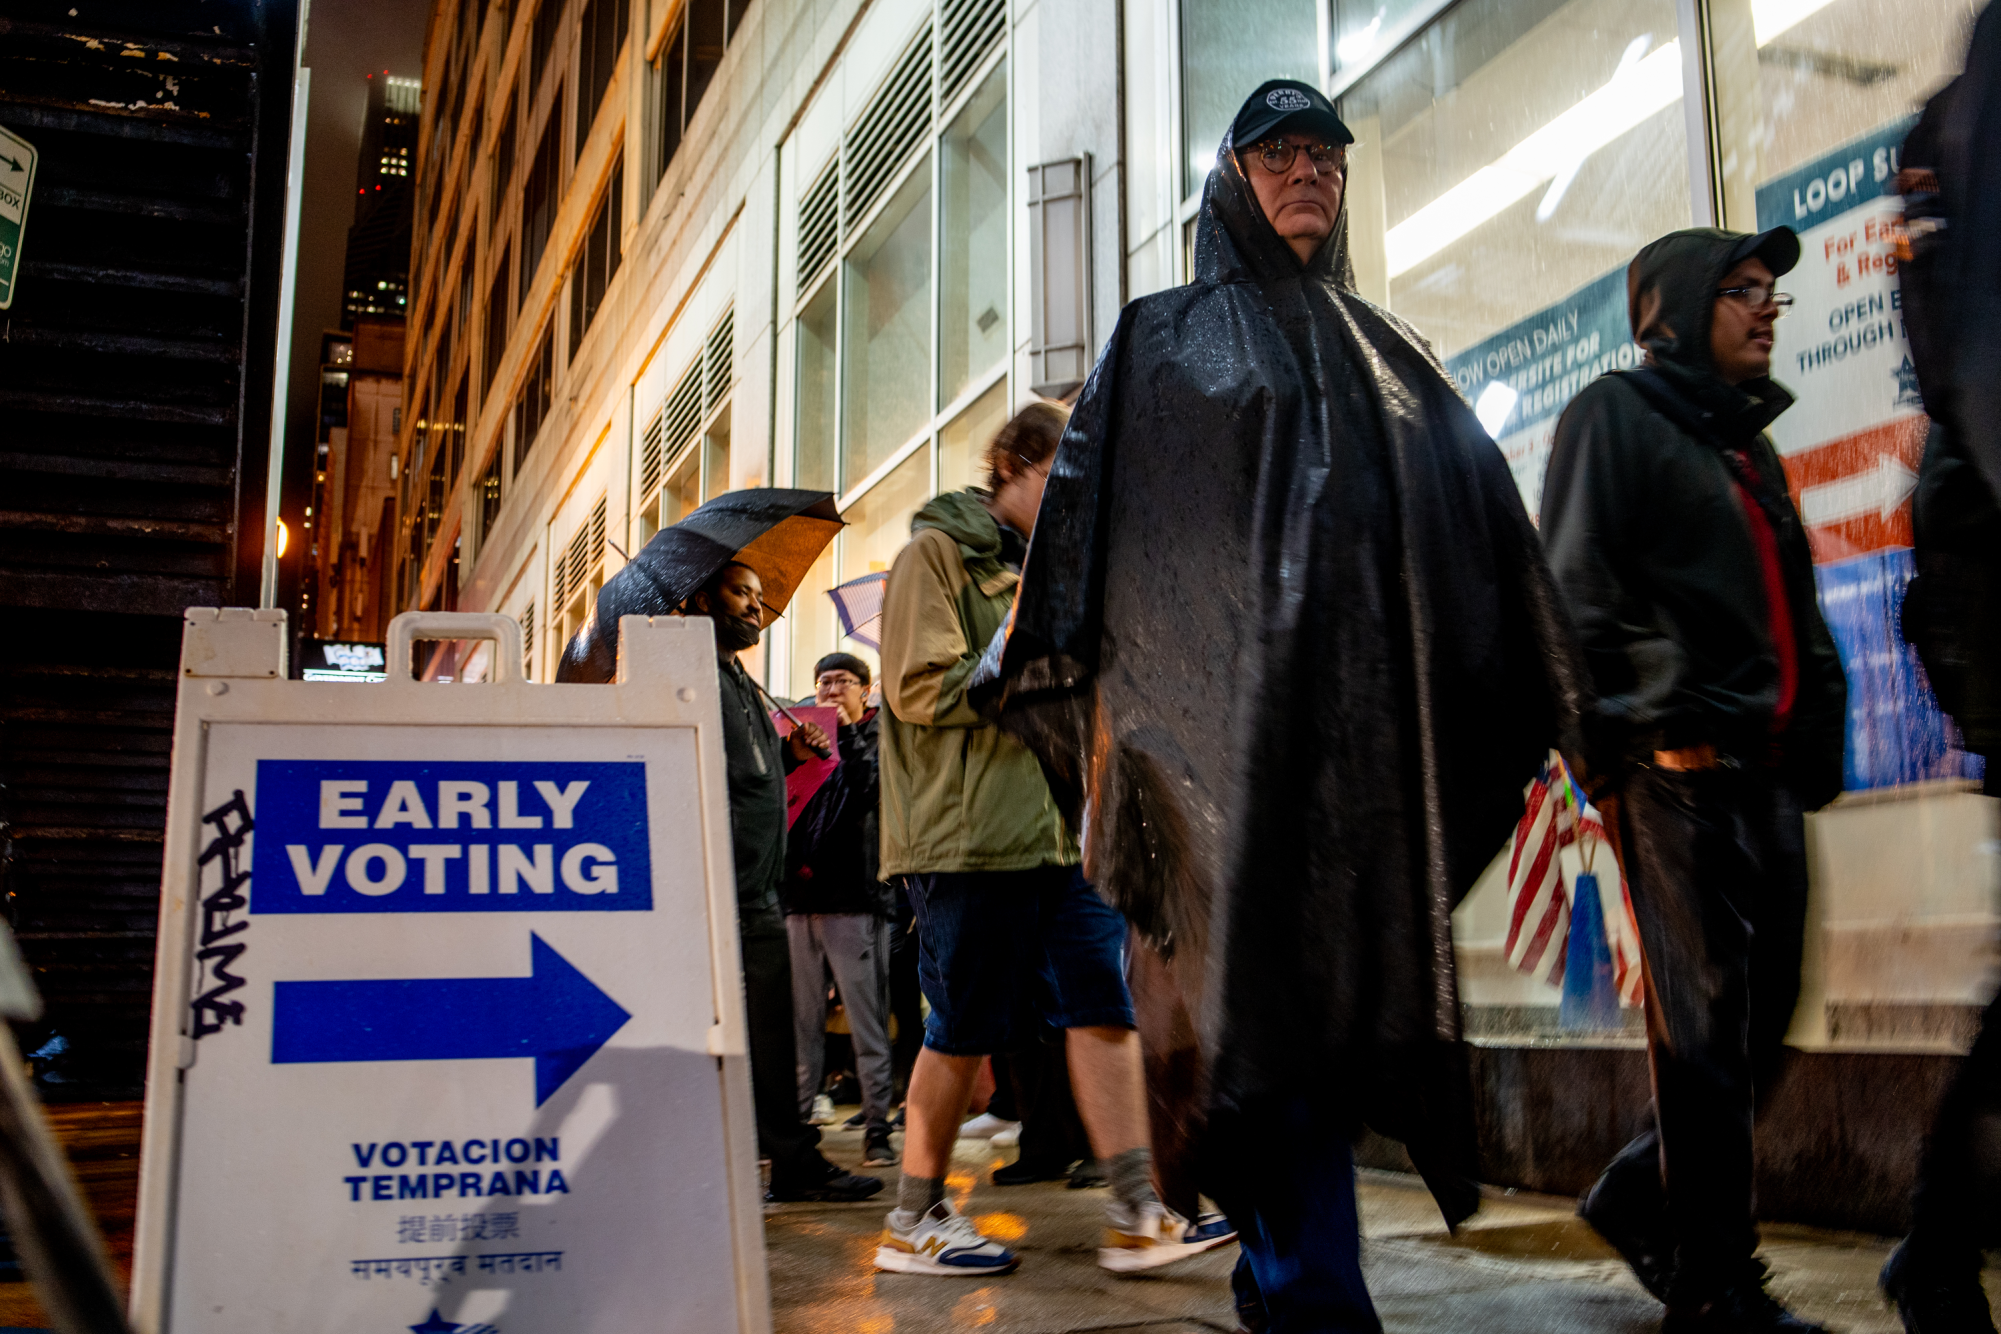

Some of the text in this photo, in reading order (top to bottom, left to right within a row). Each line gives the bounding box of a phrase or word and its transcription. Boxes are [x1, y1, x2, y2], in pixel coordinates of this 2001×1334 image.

[1793, 158, 1864, 221] LOOP
[1824, 229, 1857, 264] For
[1829, 290, 1884, 334] OPEN
[1487, 335, 1532, 377] OPEN
[1533, 308, 1579, 351] DAILY
[1567, 330, 1601, 368] FOR
[1796, 318, 1894, 376] THROUGH
[318, 780, 591, 829] EARLY
[285, 843, 620, 896] VOTING
[351, 1136, 560, 1168] VOTACION
[343, 1169, 570, 1201] TEMPRANA
[397, 1211, 520, 1244] 提前投票
[475, 1251, 565, 1274] मतदान
